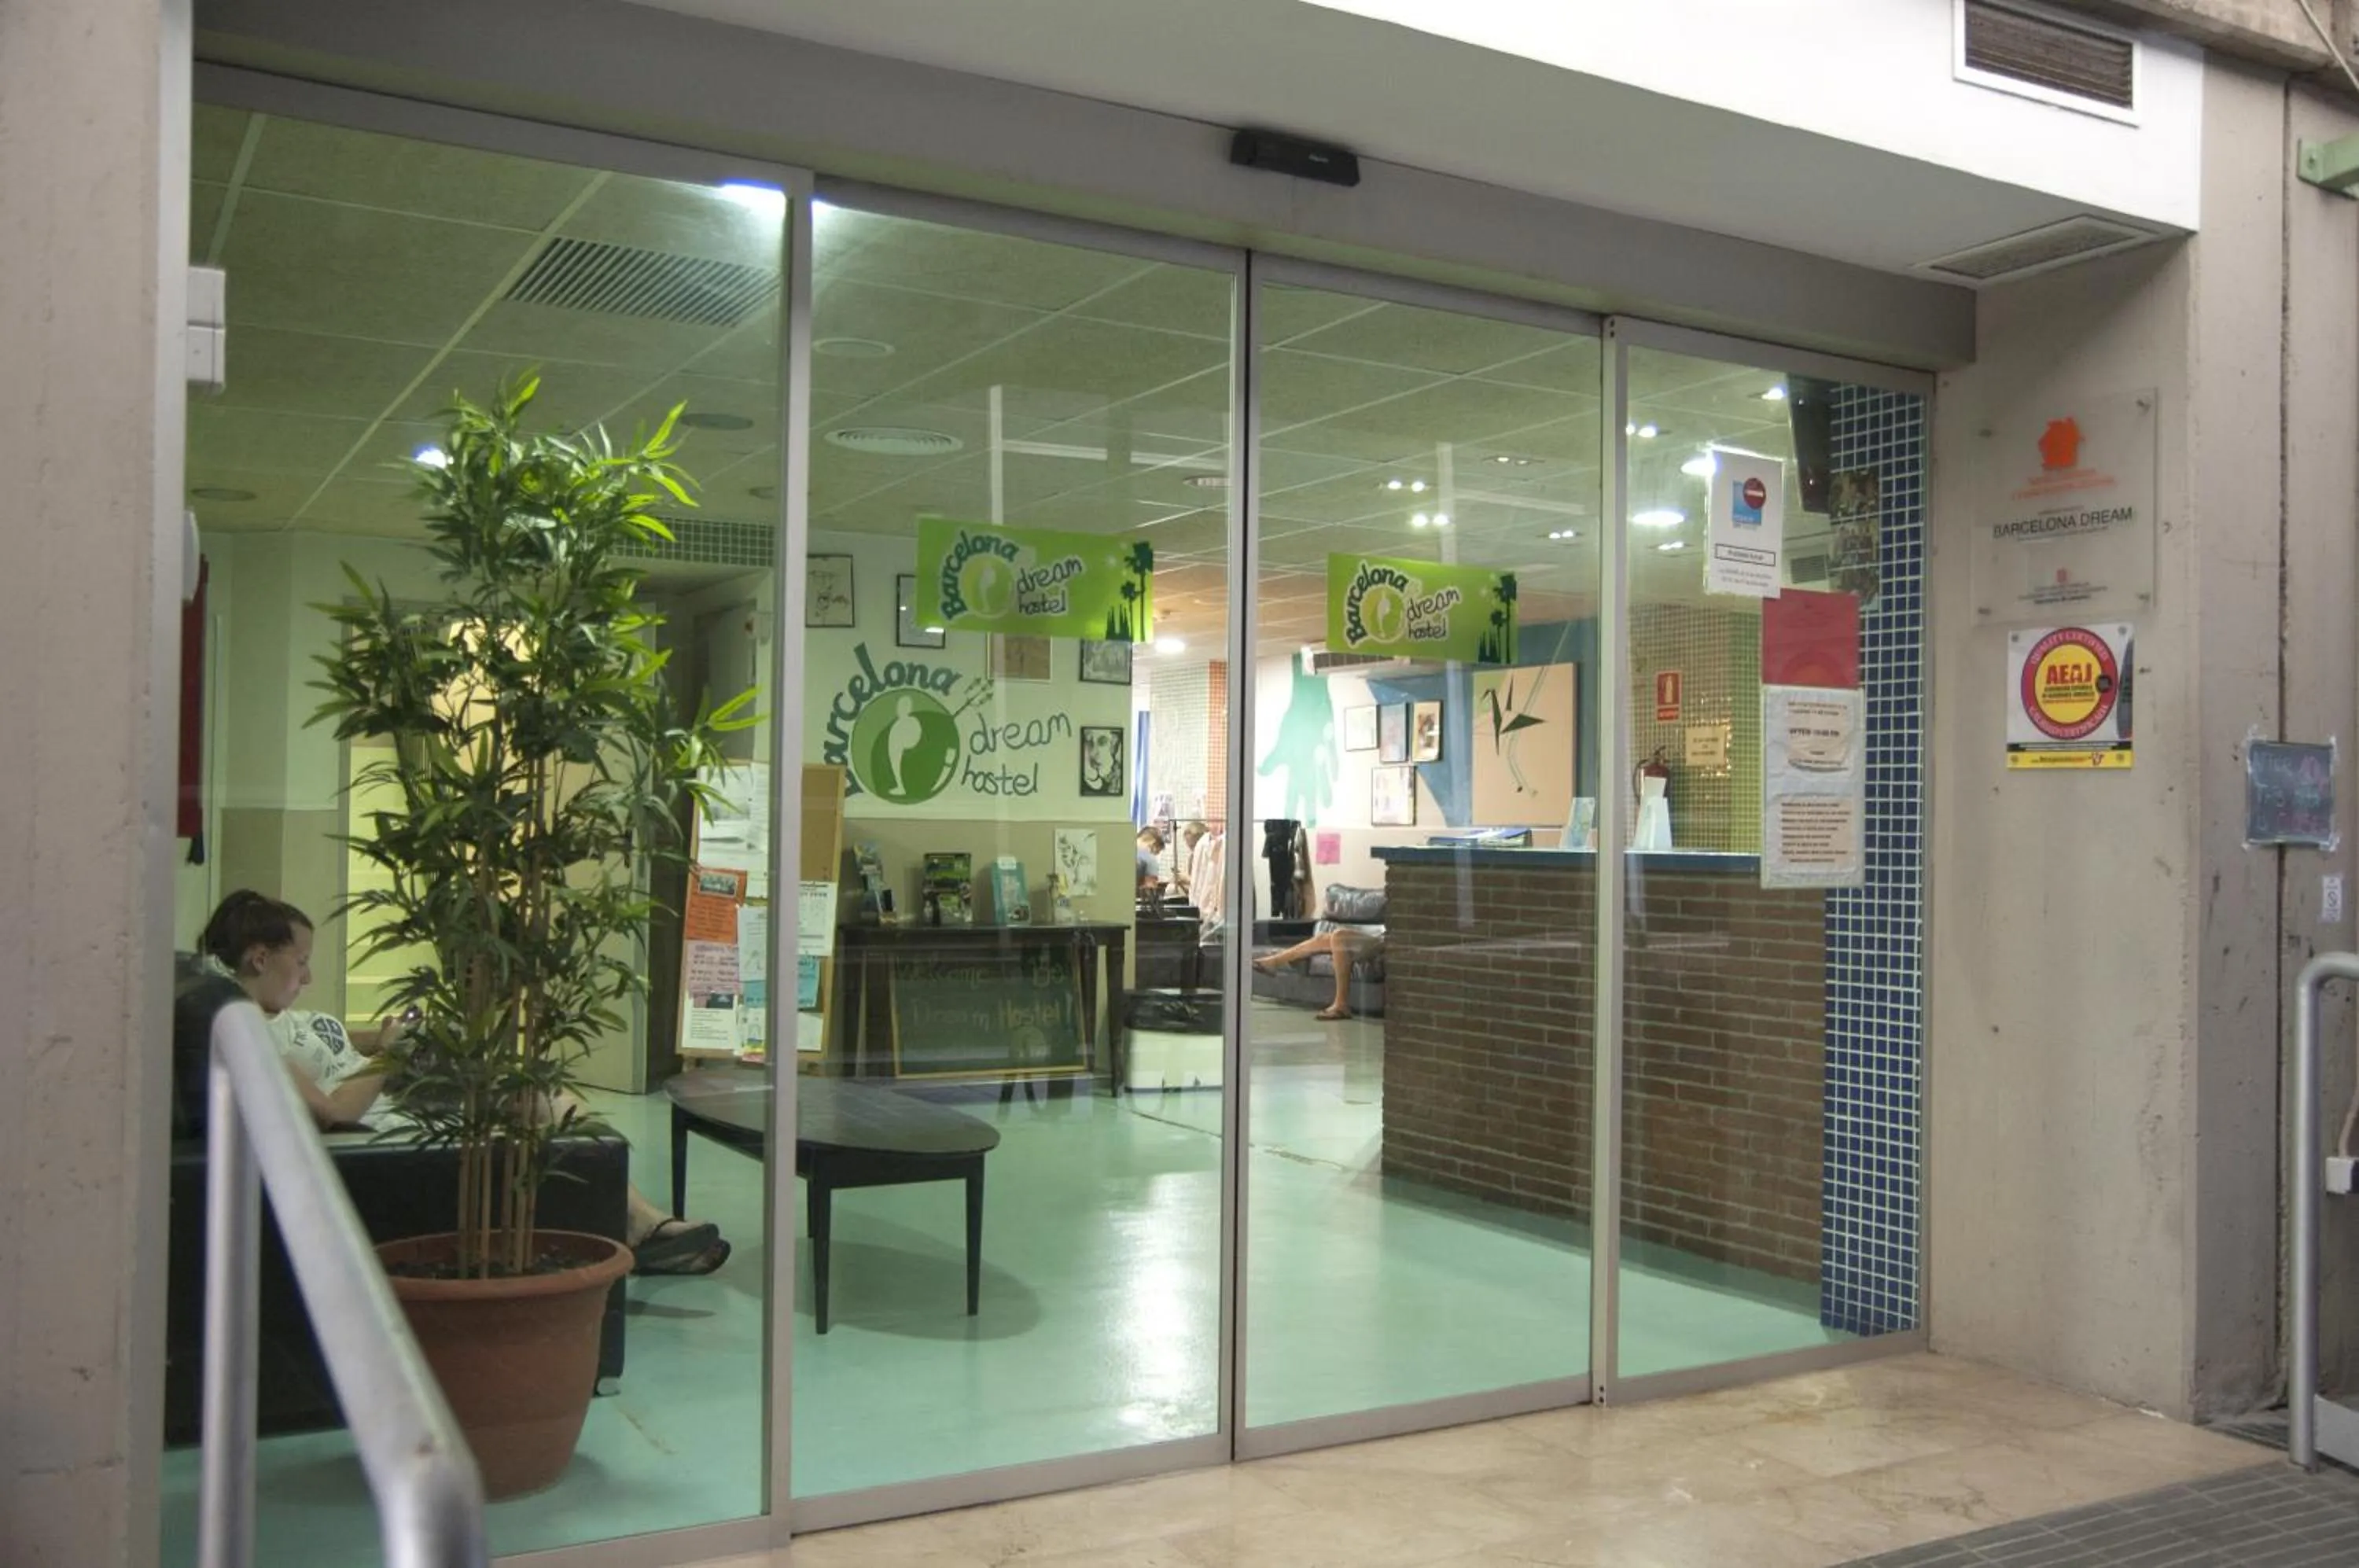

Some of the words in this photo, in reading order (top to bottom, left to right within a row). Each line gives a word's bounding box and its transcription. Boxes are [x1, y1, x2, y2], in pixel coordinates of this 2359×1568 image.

[1993, 514, 2077, 539] BARCELONA
[2080, 506, 2133, 527] DREAM
[940, 531, 1020, 620] Barcelona
[1016, 556, 1083, 594] dream
[1018, 590, 1067, 615] hostel
[1346, 564, 1409, 644] Barcelona
[1406, 588, 1460, 622] dream
[1408, 619, 1447, 639] hostel
[2046, 663, 2092, 684] AEAJ
[969, 712, 1073, 756] dream
[960, 755, 1039, 797] hostel
